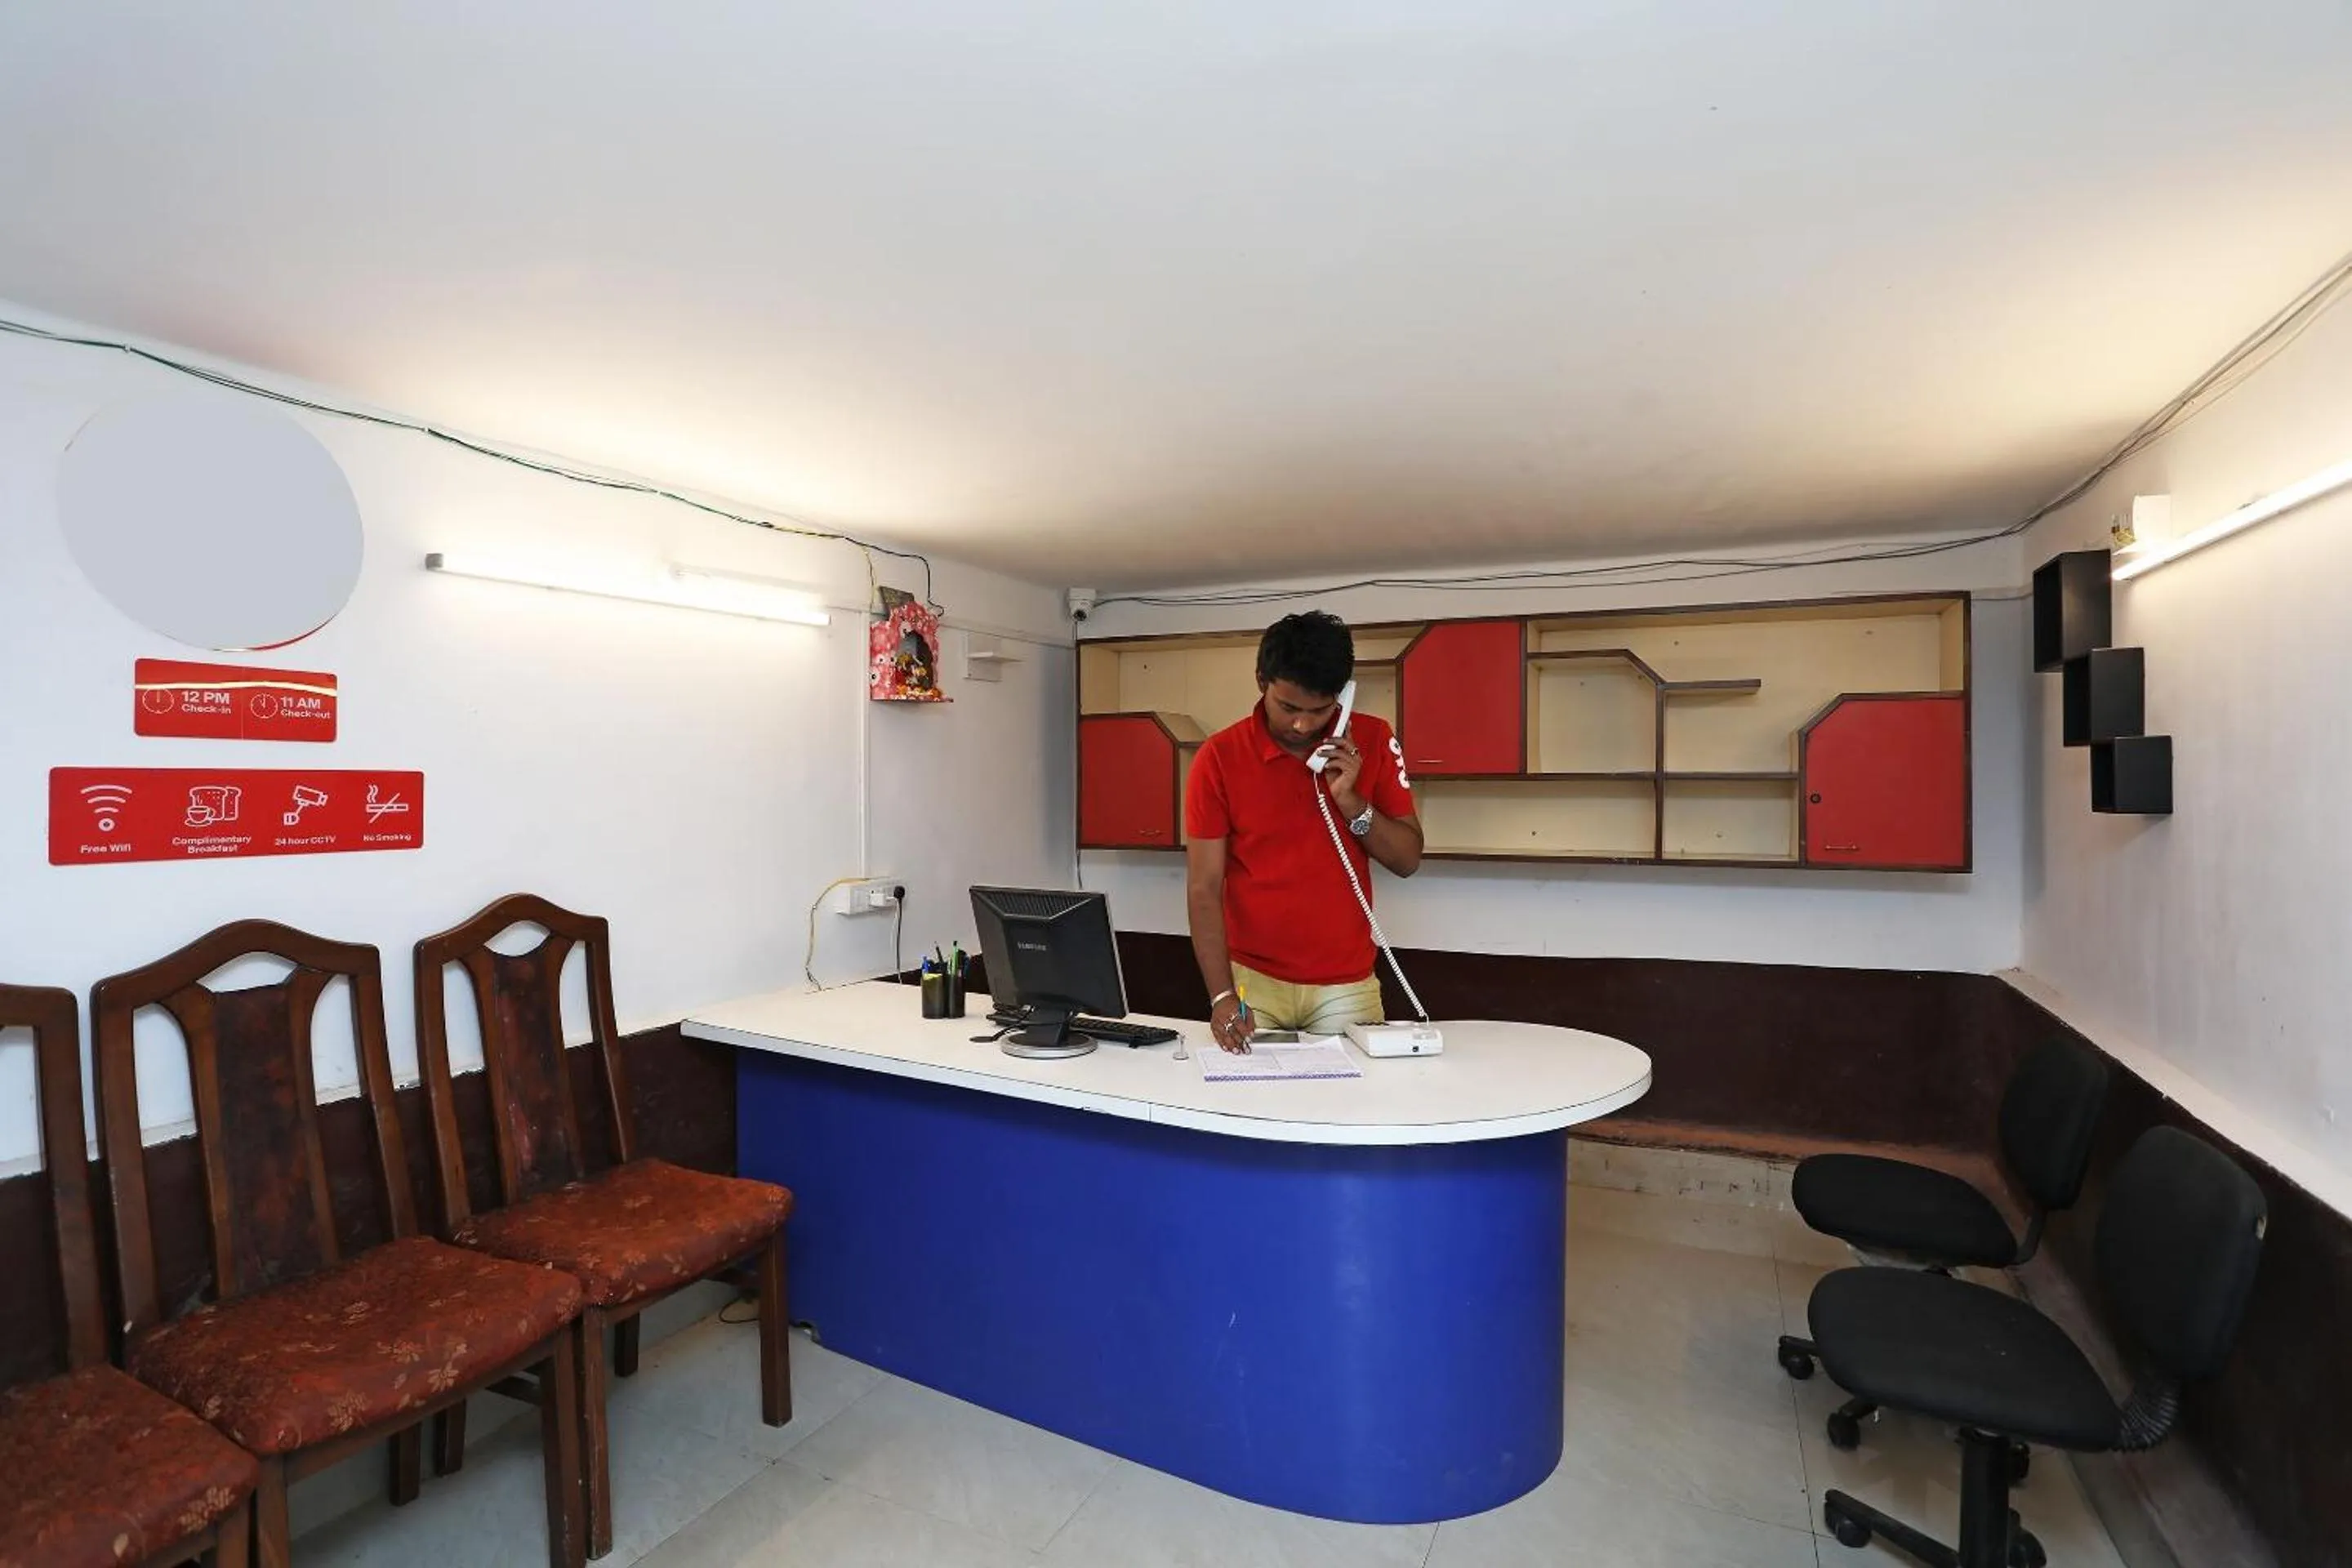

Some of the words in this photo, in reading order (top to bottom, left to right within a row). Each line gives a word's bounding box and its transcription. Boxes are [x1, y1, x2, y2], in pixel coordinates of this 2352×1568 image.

[181, 691, 199, 703] 12
[204, 692, 230, 704] PM
[181, 703, 231, 715] Check-in
[280, 697, 292, 708] 11
[296, 698, 321, 710] AM
[280, 709, 331, 719] Check-out
[172, 835, 252, 846] Complimentary
[274, 837, 287, 846] 24
[288, 837, 309, 845] hour
[310, 835, 336, 844] CCTV
[363, 834, 375, 842] No
[81, 844, 107, 854] Free
[187, 844, 238, 854] Breakfast
